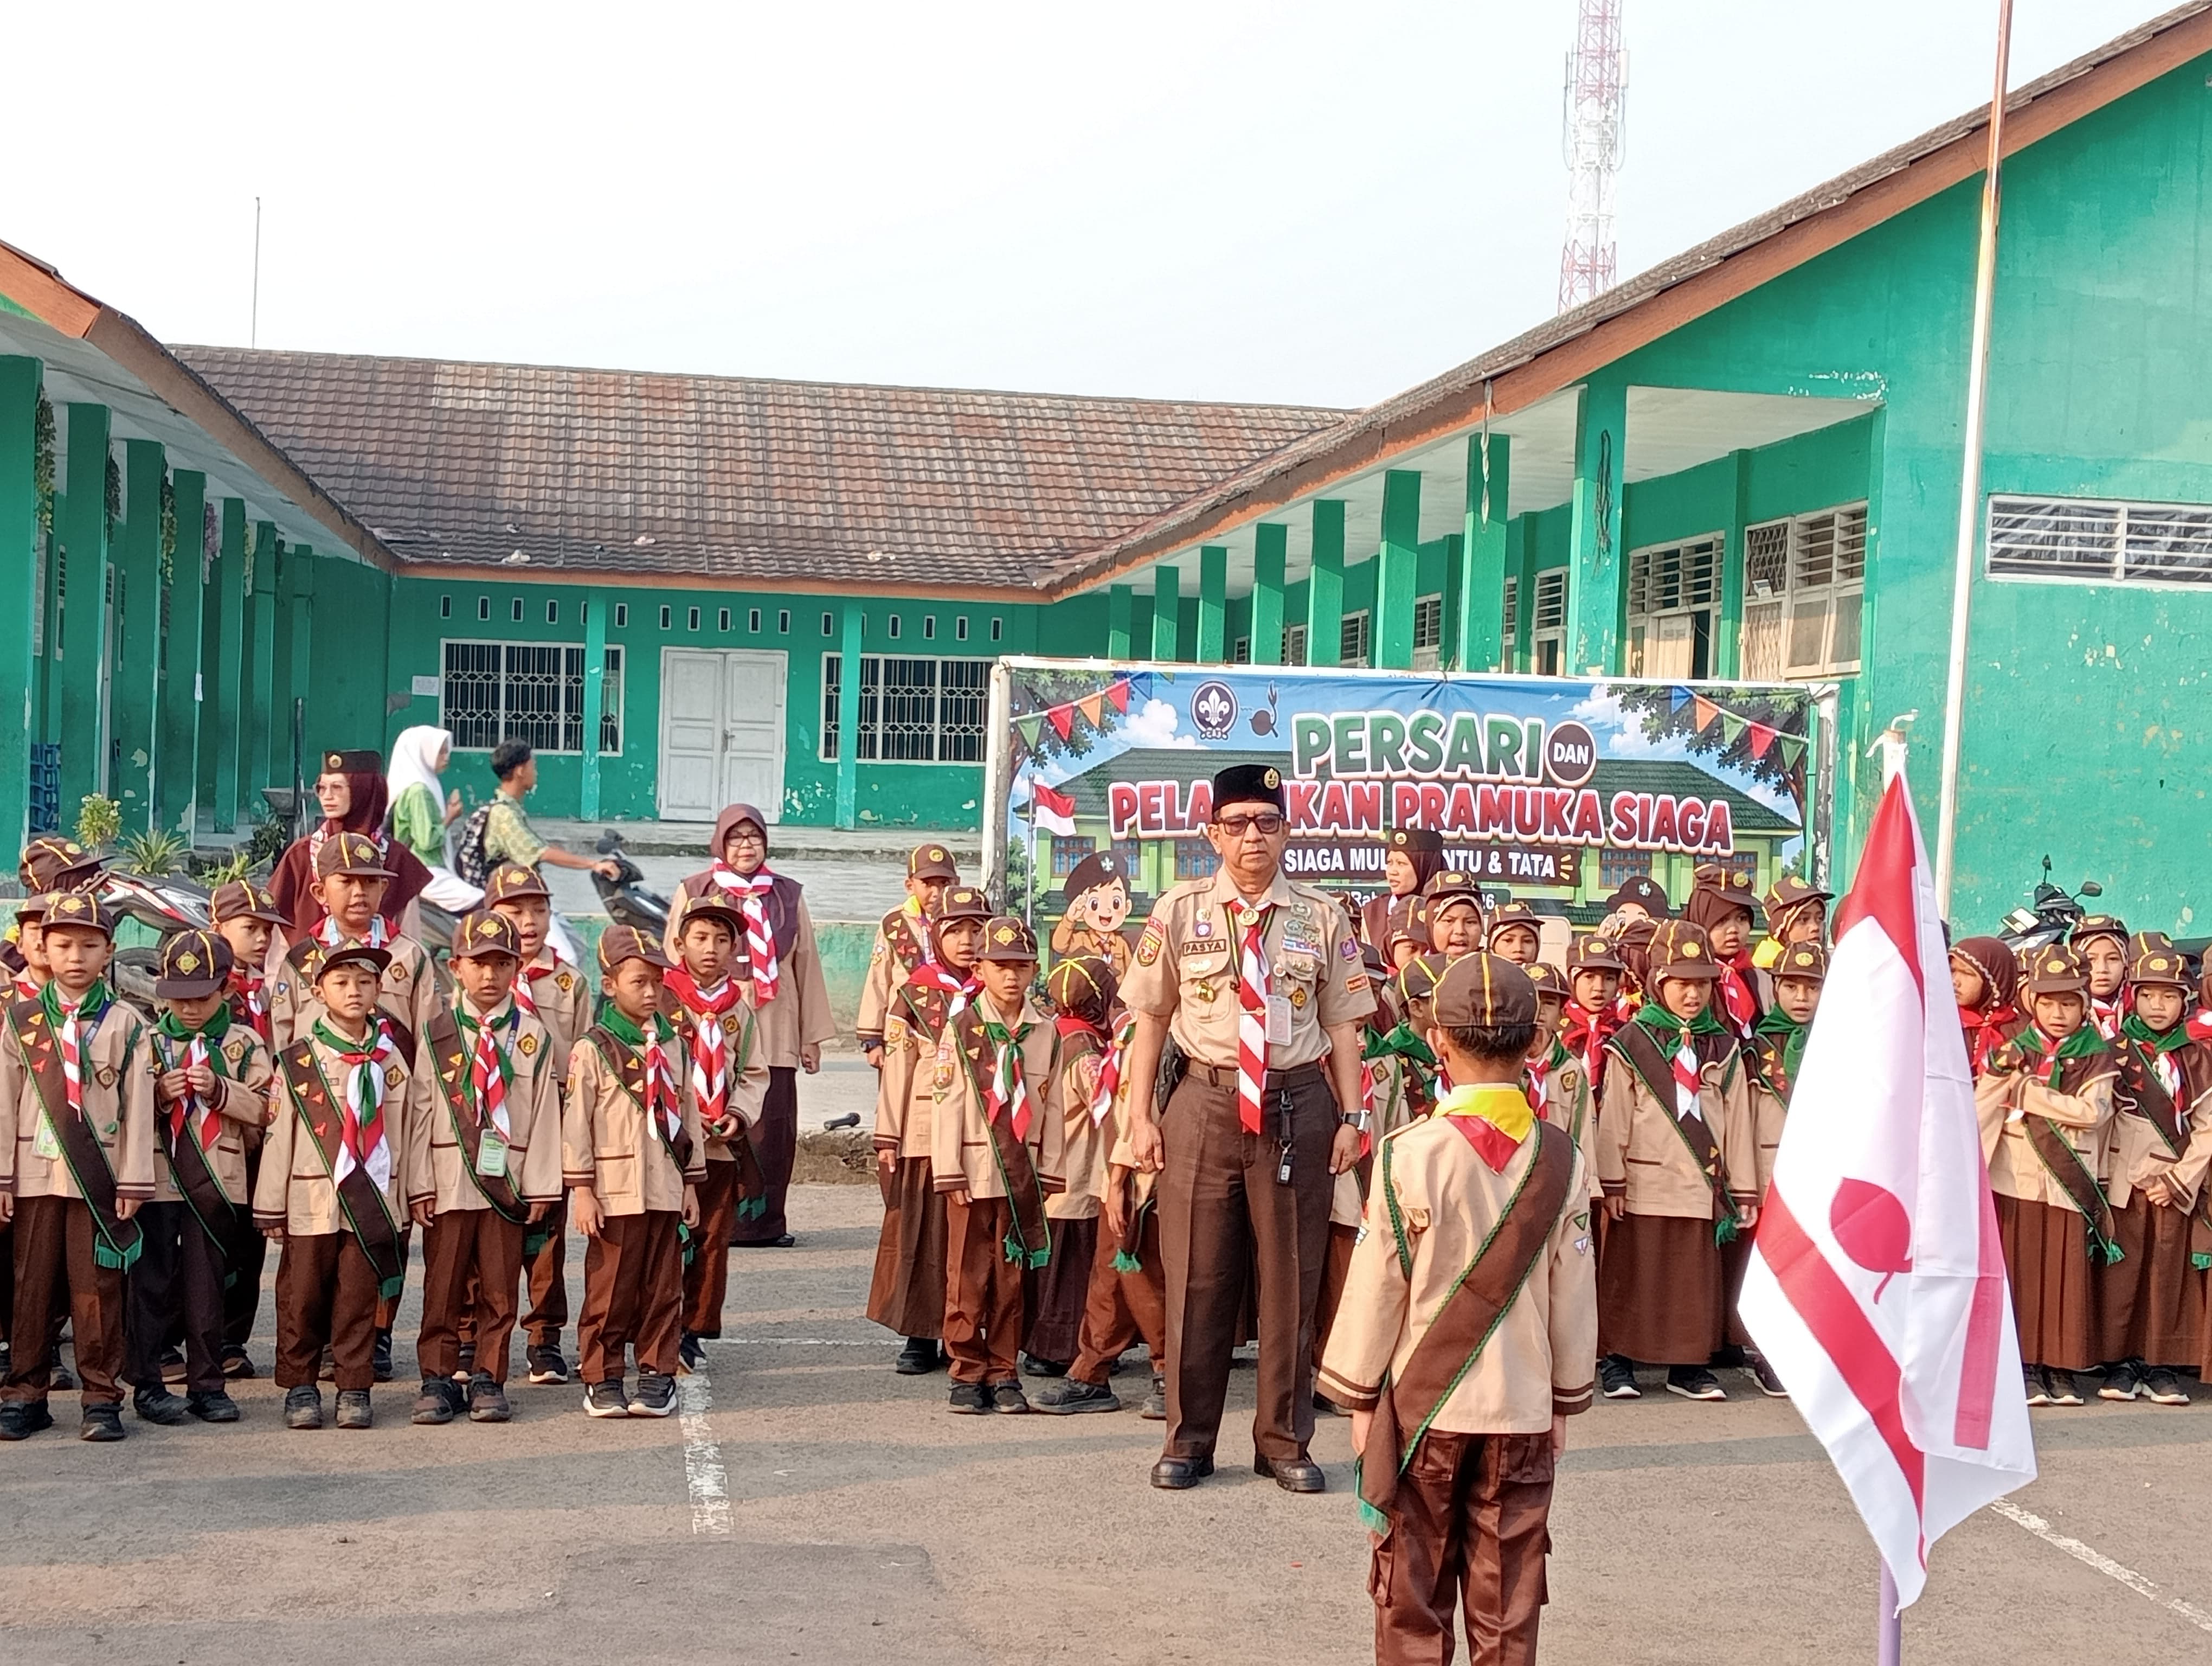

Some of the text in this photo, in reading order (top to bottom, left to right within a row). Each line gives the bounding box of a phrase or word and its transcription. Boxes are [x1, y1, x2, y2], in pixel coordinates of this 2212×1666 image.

[1294, 711, 1544, 782] PERSARI
[1553, 742, 1590, 765] DAN
[1110, 781, 1733, 854] PELAKAN PRAMUKA SIAGA
[1284, 848, 1555, 878] SIAGA MUL NTU & TATA
[1186, 942, 1221, 953] PASYA
